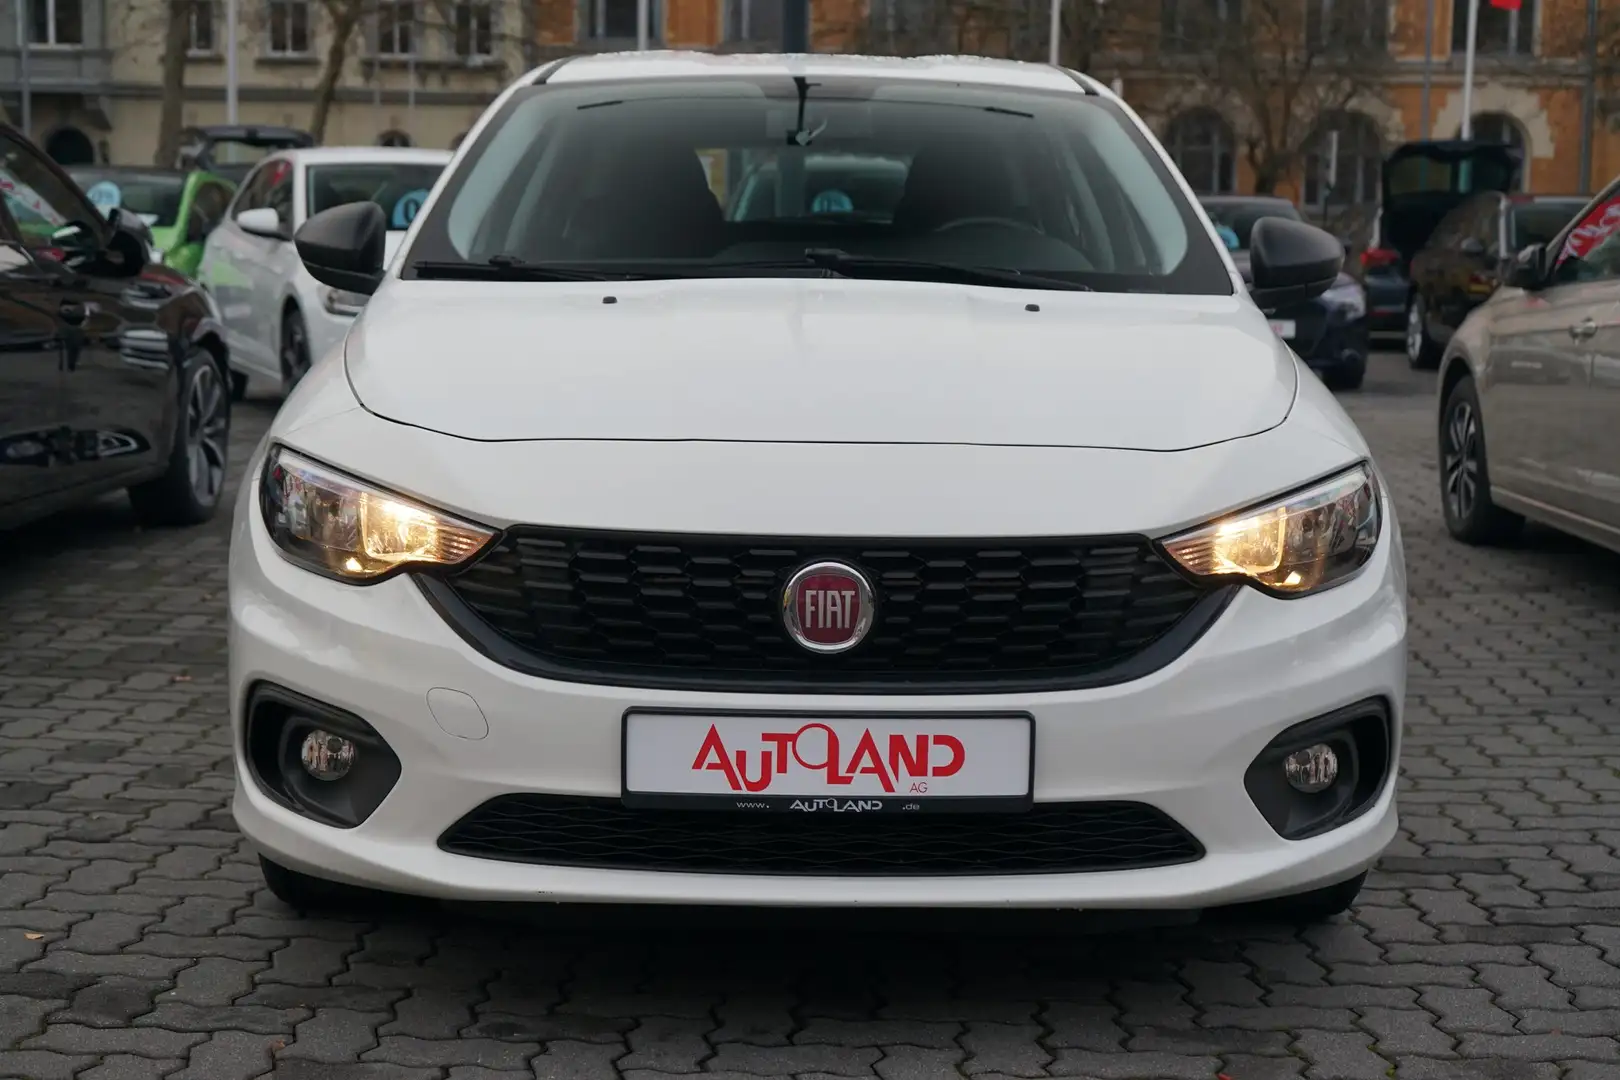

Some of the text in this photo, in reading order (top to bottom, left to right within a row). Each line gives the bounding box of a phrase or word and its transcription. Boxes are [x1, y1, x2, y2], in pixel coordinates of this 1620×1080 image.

[805, 590, 856, 629] FIAT
[692, 723, 965, 792] AUTOLAND
[909, 782, 928, 793] AG
[790, 798, 883, 812] AUTOLAND
